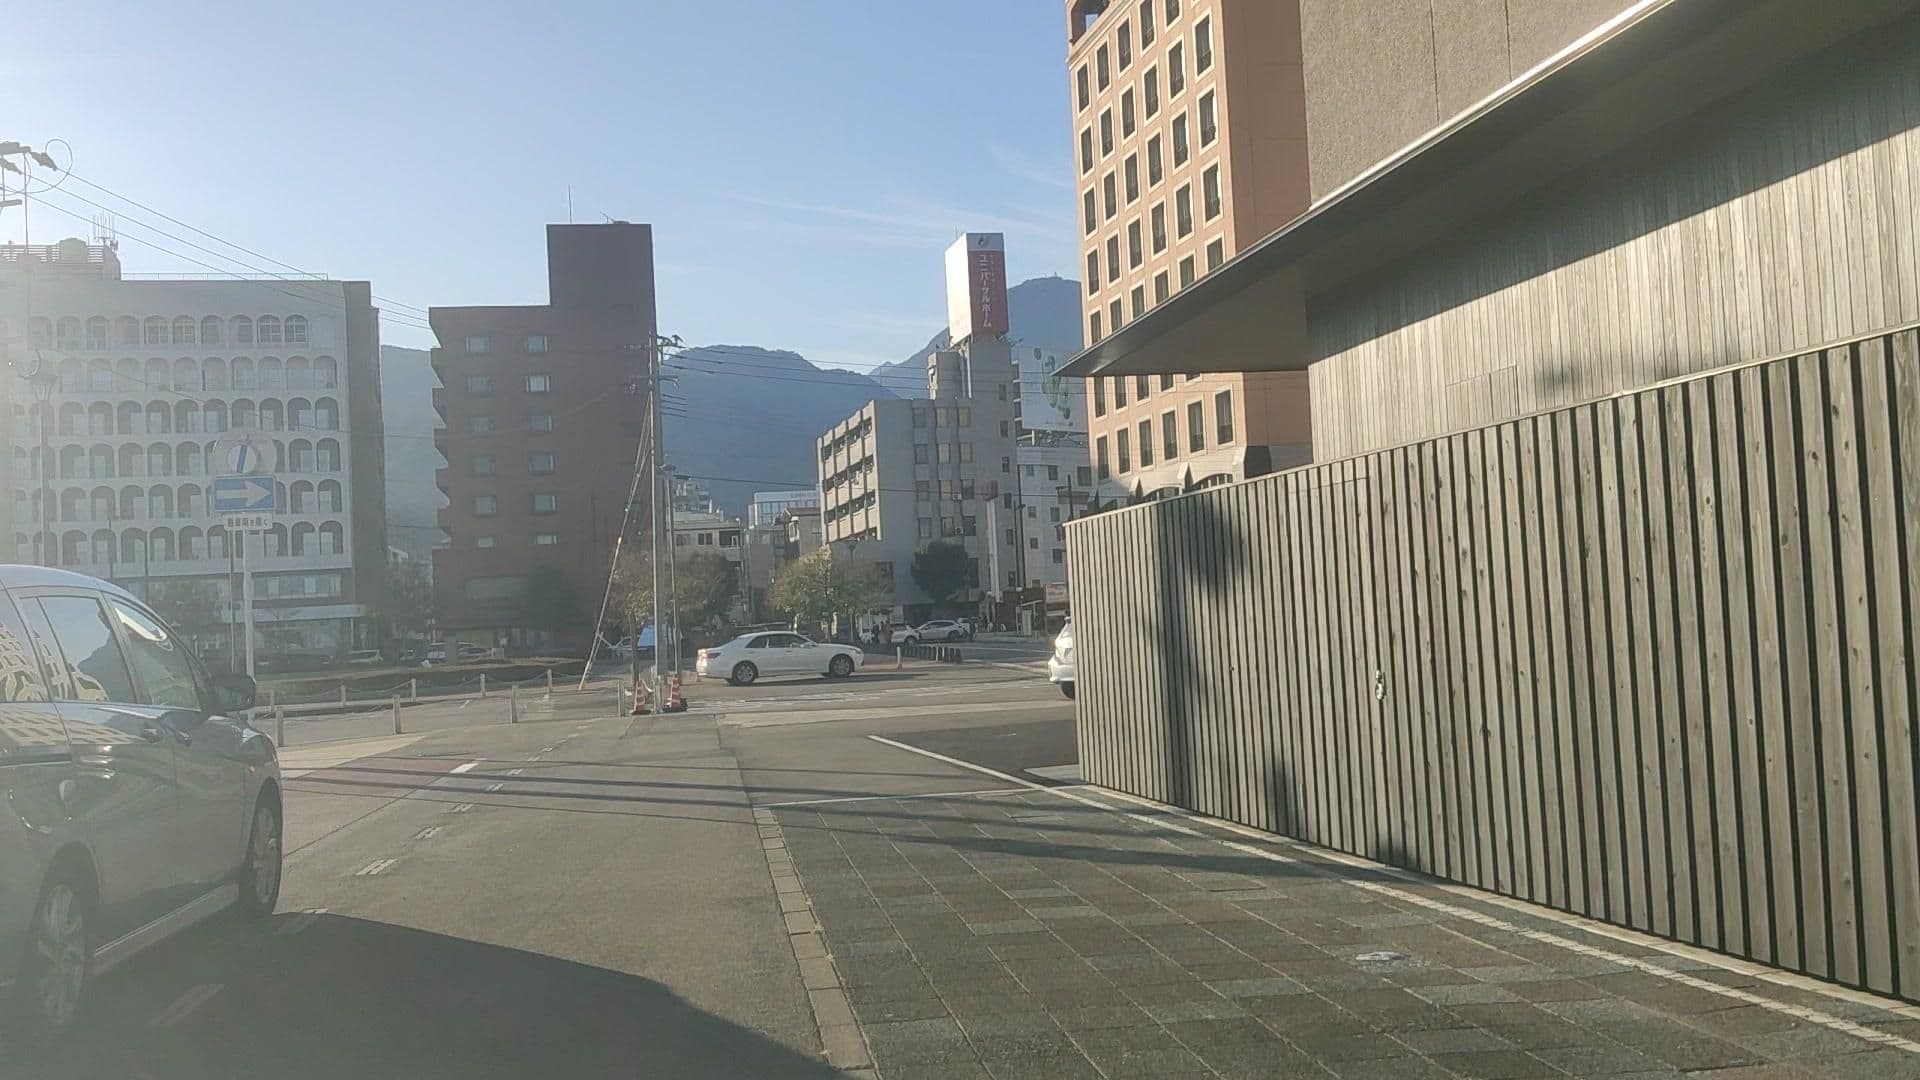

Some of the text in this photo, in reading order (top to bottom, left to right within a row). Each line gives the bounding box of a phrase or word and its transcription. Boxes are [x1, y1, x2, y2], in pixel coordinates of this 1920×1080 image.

[979, 254, 992, 328] ユニバーサルホーム
